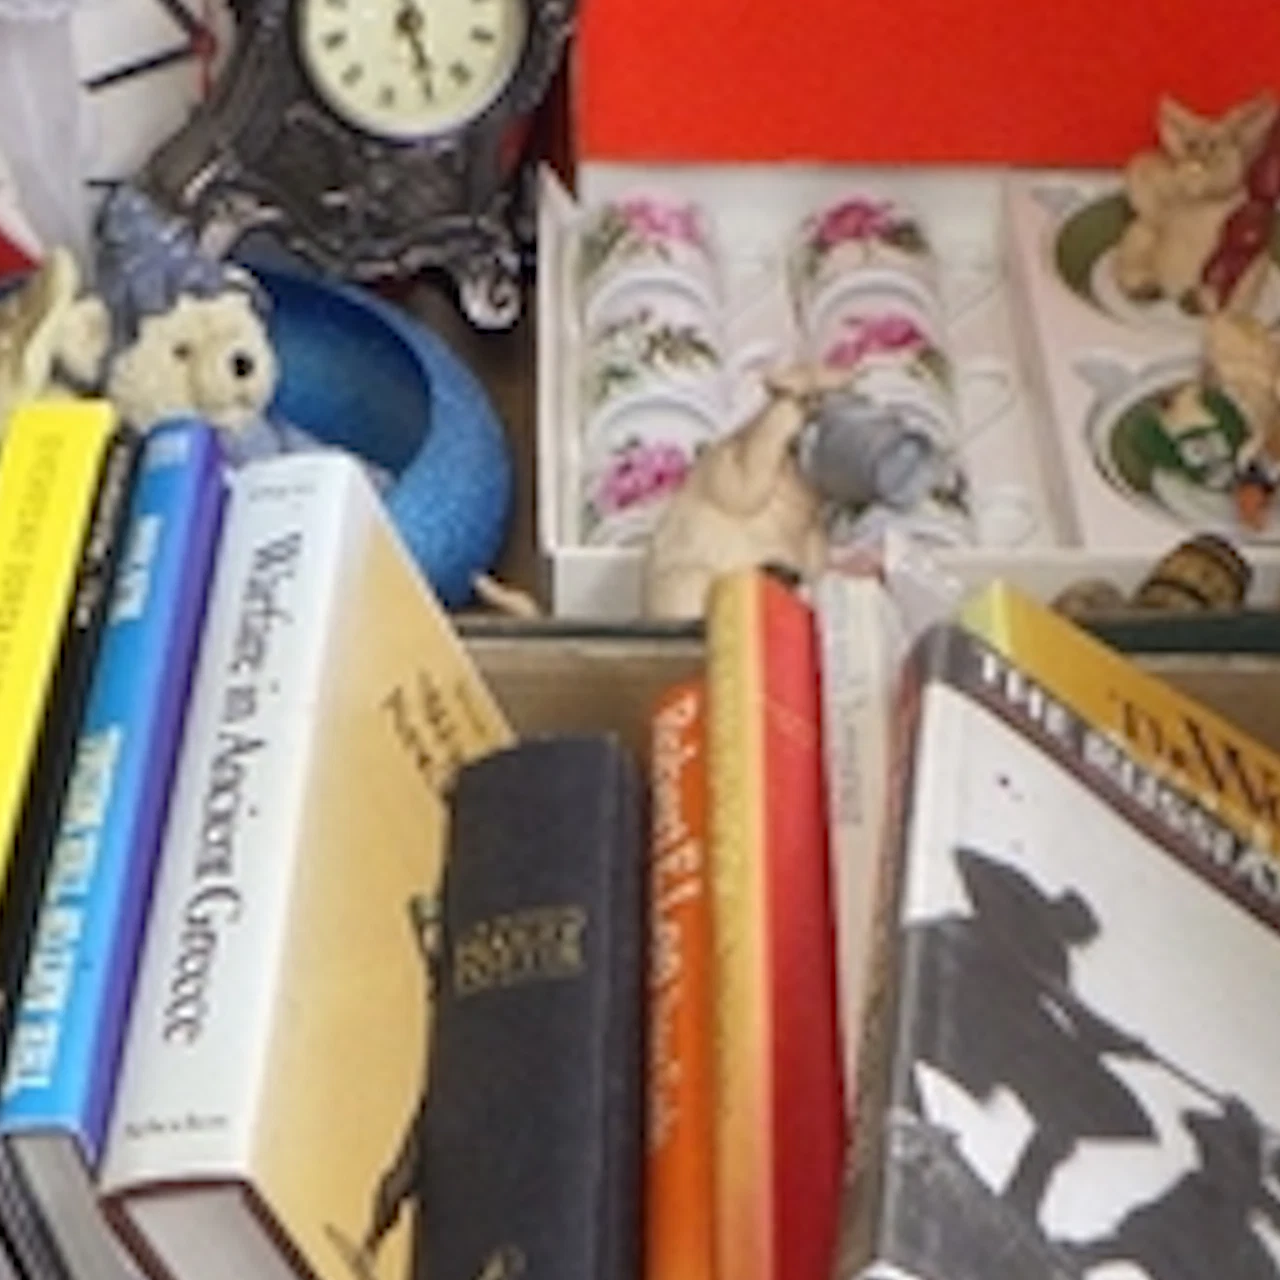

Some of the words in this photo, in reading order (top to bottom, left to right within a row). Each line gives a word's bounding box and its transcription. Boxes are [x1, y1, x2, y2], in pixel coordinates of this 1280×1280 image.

[228, 530, 304, 674] Warfare
[220, 684, 281, 724] in
[978, 650, 1070, 736] THE
[190, 728, 266, 898] Ancient
[162, 886, 242, 1048] Greece
